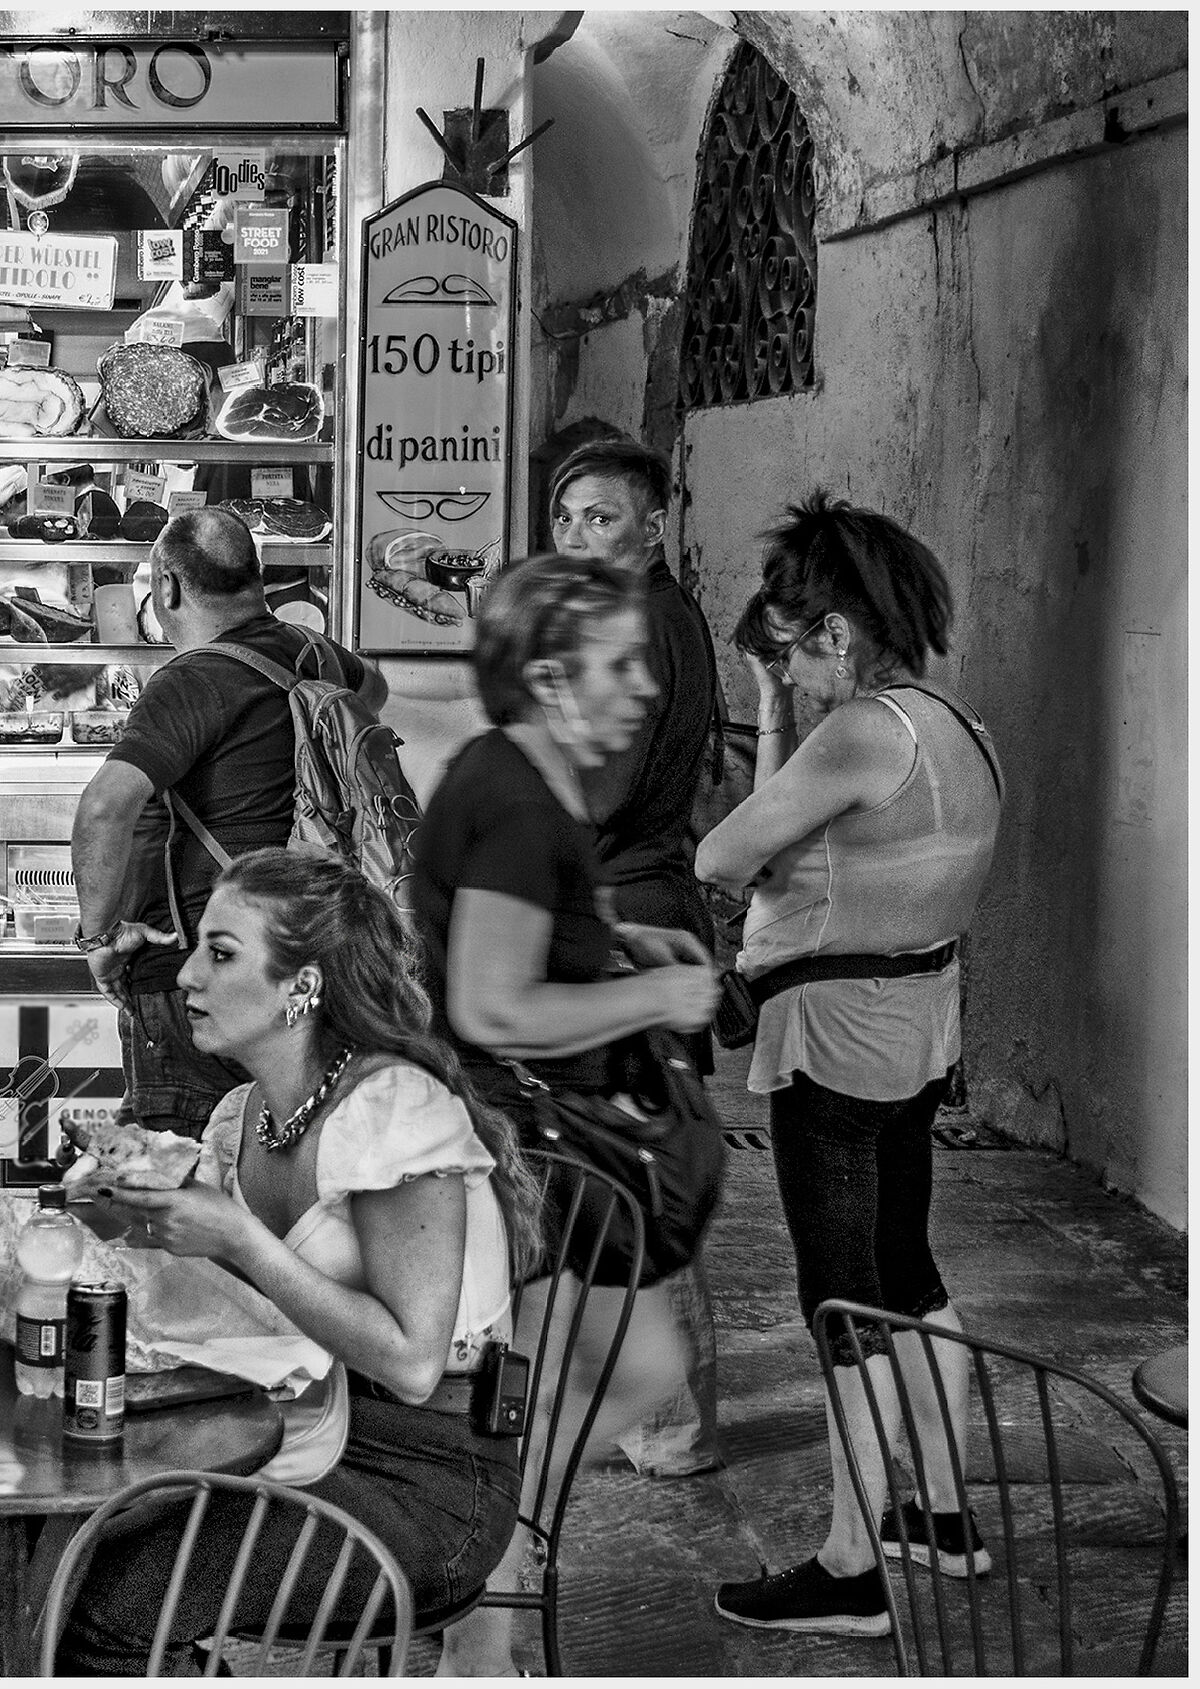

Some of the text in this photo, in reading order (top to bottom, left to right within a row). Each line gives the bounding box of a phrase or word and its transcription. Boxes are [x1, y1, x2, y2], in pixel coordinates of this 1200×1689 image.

[240, 227, 282, 238] STREET
[369, 213, 508, 262] GRAN RISTORO
[244, 238, 279, 248] FOOD
[253, 248, 269, 256] 2021
[30, 244, 101, 270] WÜRSTEL
[367, 333, 506, 385] 150 tipi
[366, 423, 502, 471] di panini
[60, 1108, 120, 1120] GENOV
